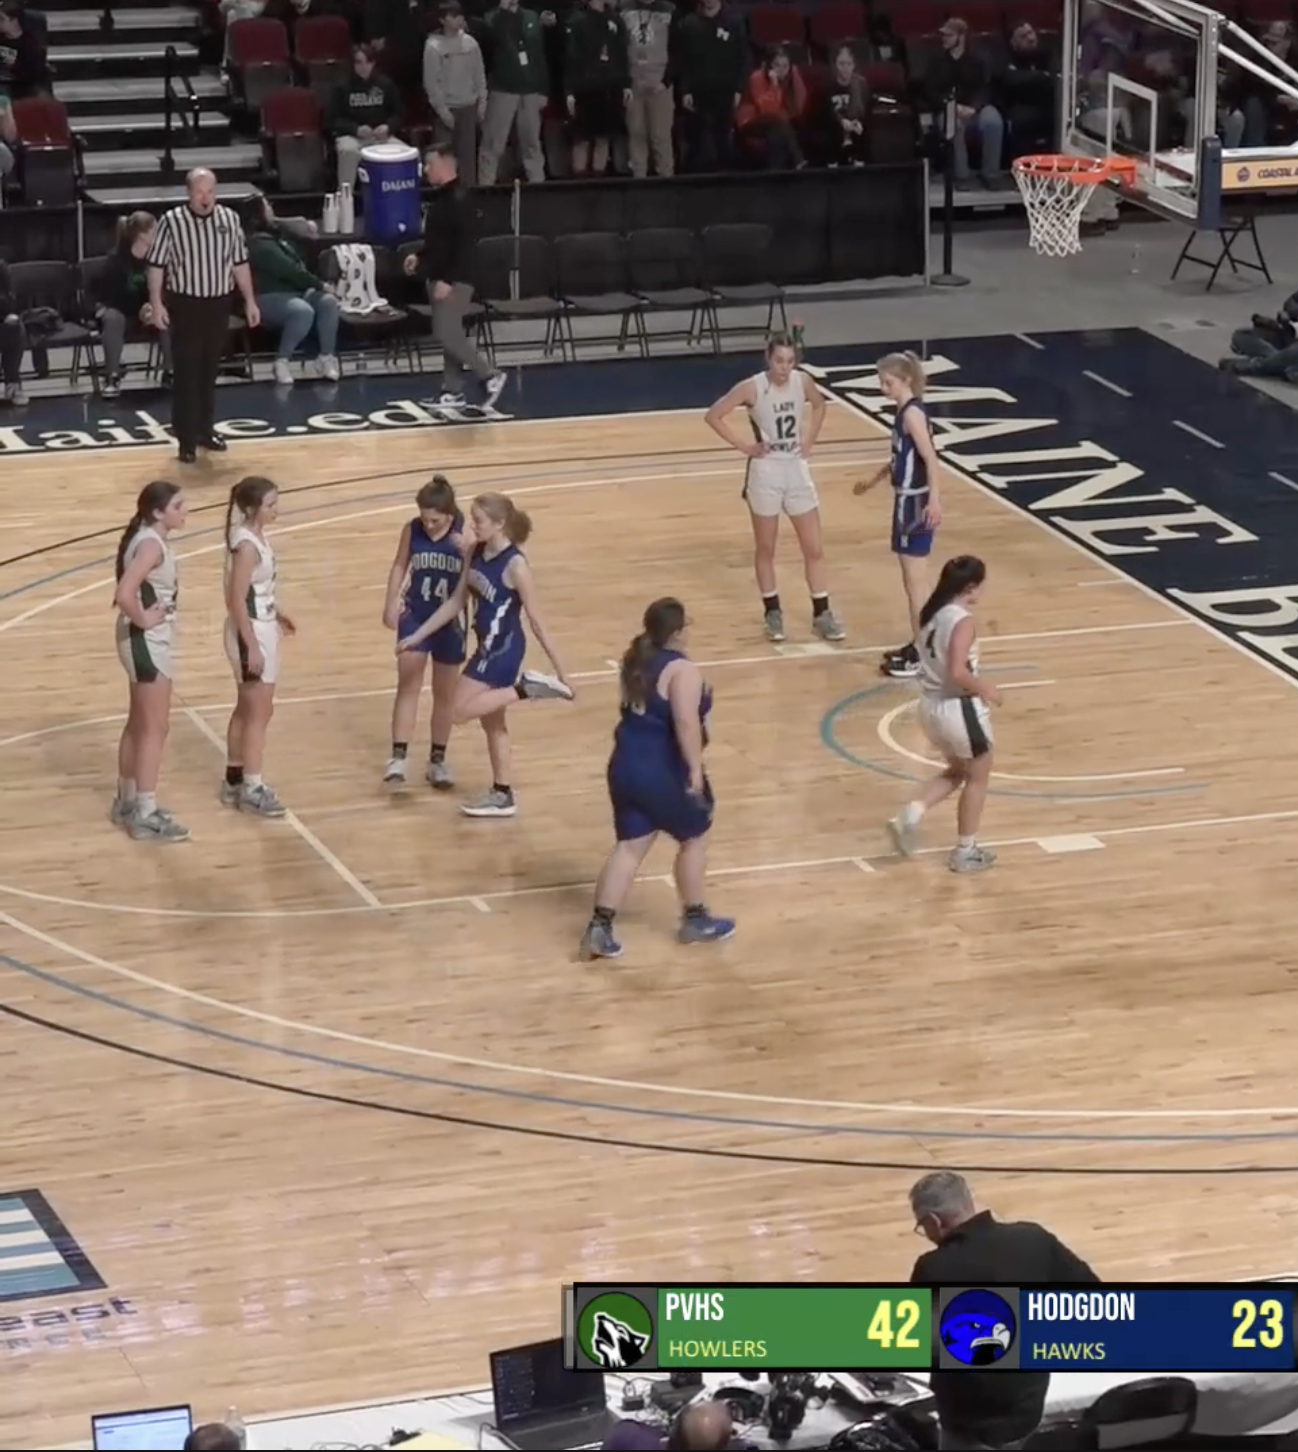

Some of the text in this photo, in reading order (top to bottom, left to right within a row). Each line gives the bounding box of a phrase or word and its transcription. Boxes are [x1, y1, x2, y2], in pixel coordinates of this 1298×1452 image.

[773, 402, 794, 413] LADY
[776, 415, 796, 440] 12
[410, 552, 462, 573] ODGDON
[421, 576, 448, 602] 44
